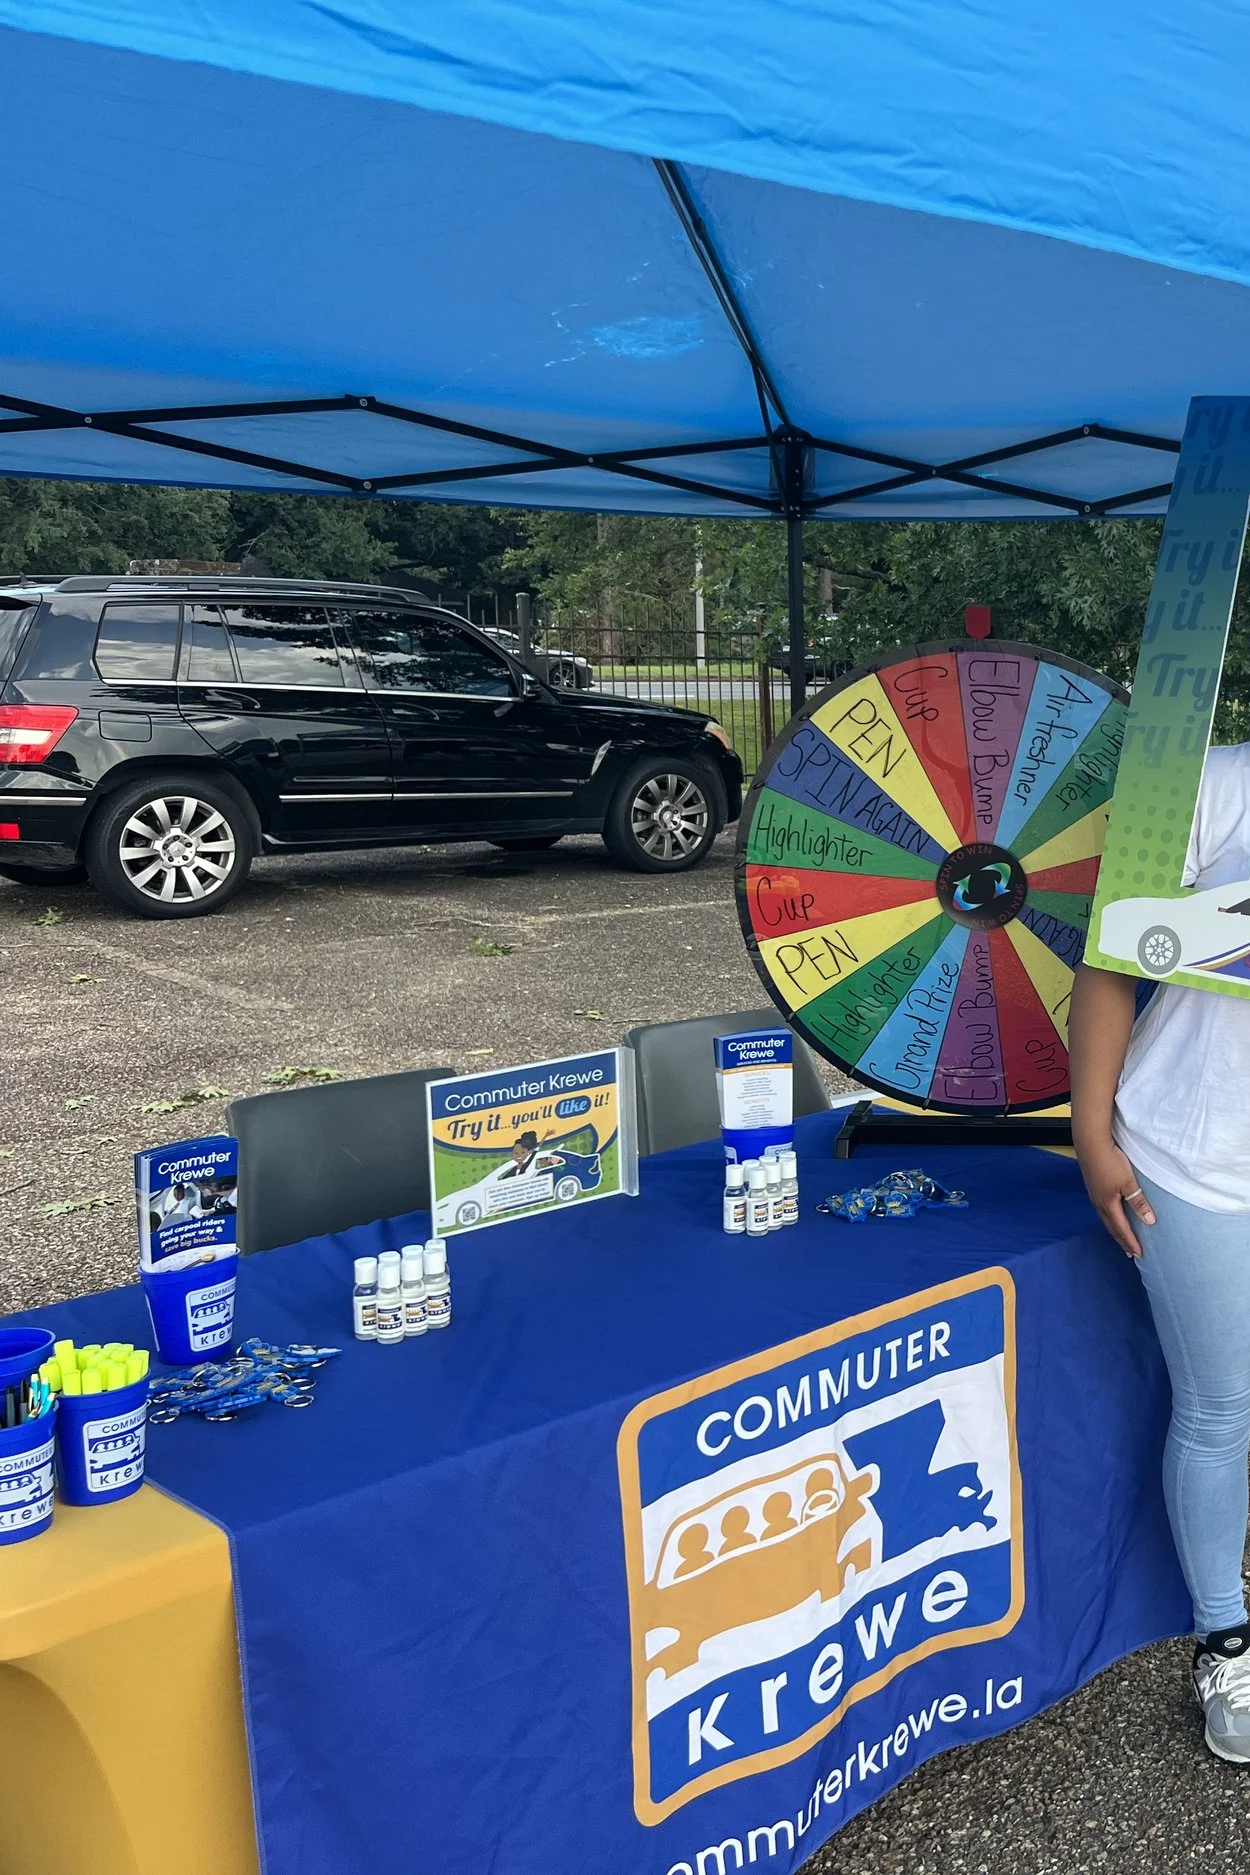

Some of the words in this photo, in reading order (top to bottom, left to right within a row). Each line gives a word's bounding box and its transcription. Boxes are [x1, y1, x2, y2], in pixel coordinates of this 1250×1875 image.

[894, 666, 948, 722] Cup
[968, 660, 1021, 742] Elbow
[1046, 674, 1093, 718] Air
[829, 698, 907, 779] PEN
[1014, 720, 1079, 806] freshner
[1055, 711, 1128, 812] ighlighter
[778, 729, 868, 814] SPIN
[853, 793, 932, 854] AGAIN
[973, 749, 1010, 825] Bump
[754, 803, 873, 867] Highlighter
[940, 864, 953, 891] SPIN
[950, 851, 965, 864] TO
[966, 845, 993, 855] WIN
[1010, 883, 1024, 909] SPIN
[756, 877, 815, 927] Cup
[1000, 910, 1014, 921] TO
[776, 929, 859, 995] PEN
[957, 944, 995, 1019] Bump
[811, 946, 923, 1053] Highlighter
[868, 1013, 941, 1090] Grand
[908, 962, 960, 1018] Prize
[728, 1038, 785, 1052] Commuter
[740, 1050, 775, 1060] Krewe
[944, 1024, 999, 1101] Elbow
[445, 1080, 546, 1111] Commuter
[549, 1068, 604, 1091] Krewe
[447, 1119, 483, 1141] Try
[558, 1099, 588, 1116] like
[594, 1092, 610, 1108] it!
[157, 1151, 232, 1176] Commuter
[170, 1166, 216, 1185] Krewe
[159, 1227, 174, 1239] Find
[174, 1220, 201, 1233] carpool
[202, 1219, 226, 1227] riders
[161, 1236, 179, 1248] going
[180, 1231, 197, 1240] your
[696, 1321, 950, 1457] COMMUTER
